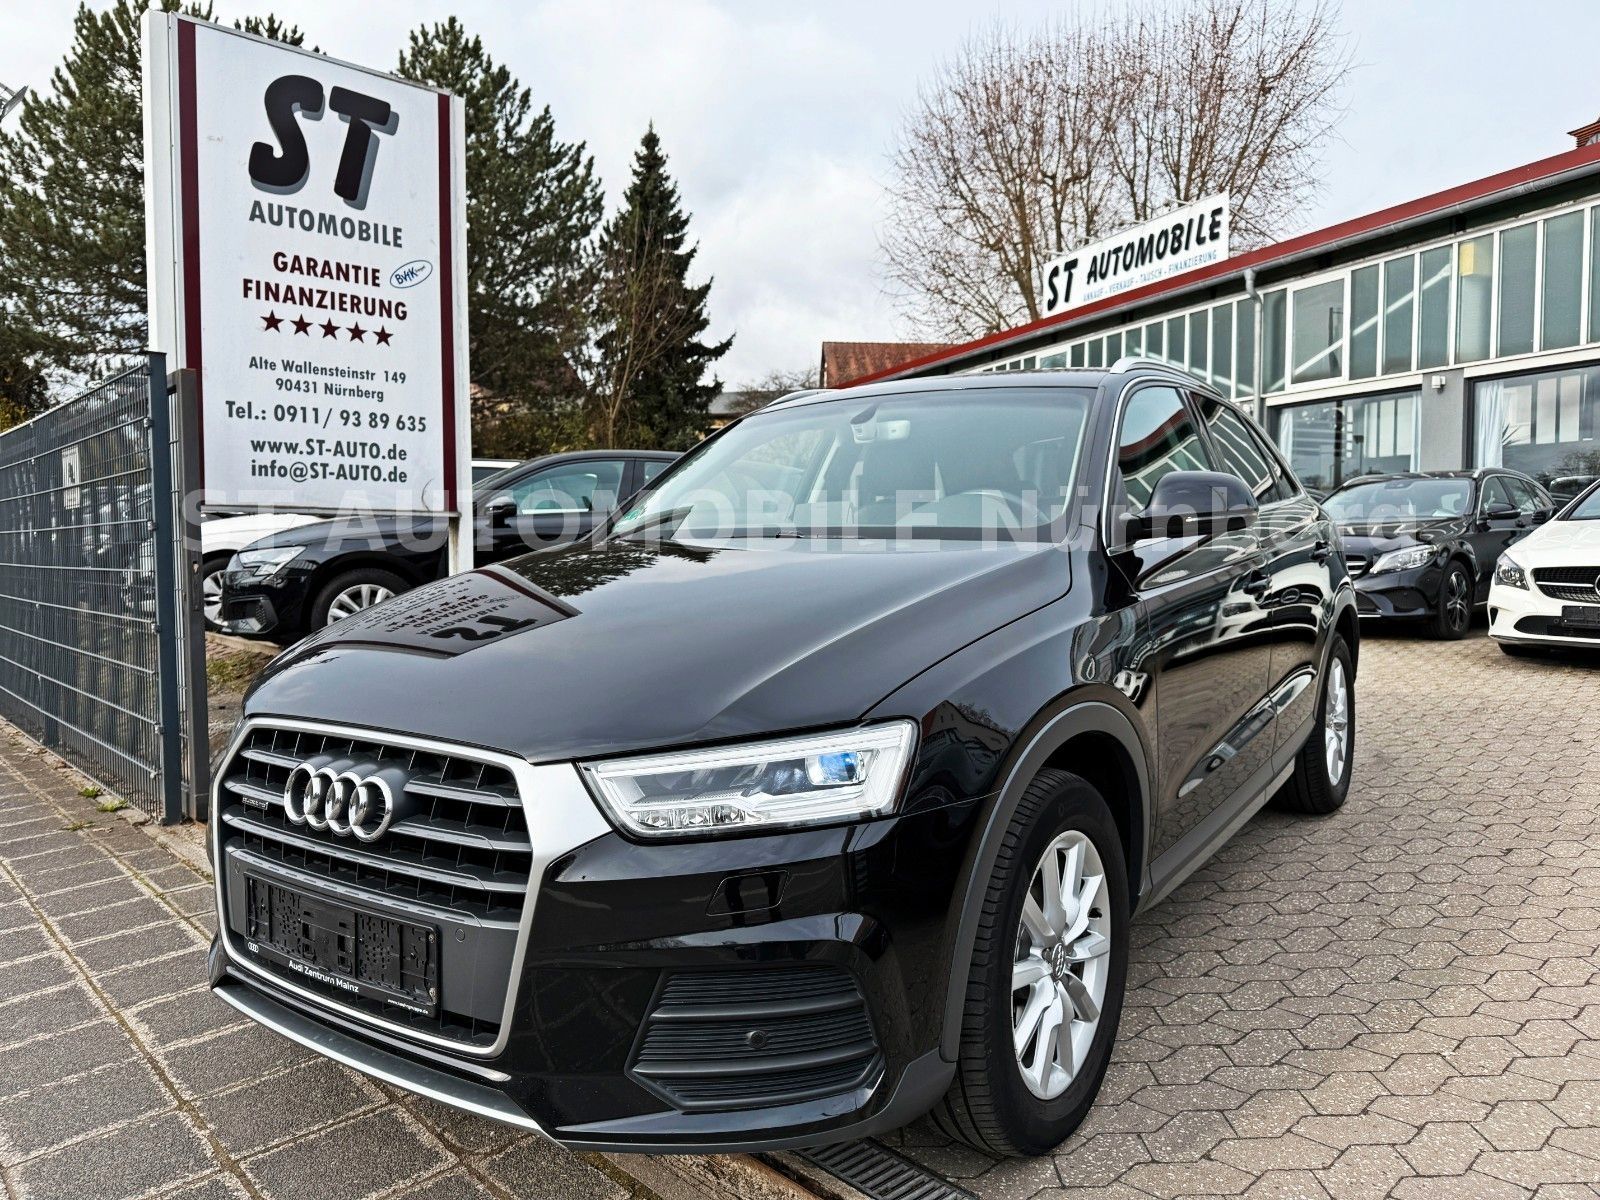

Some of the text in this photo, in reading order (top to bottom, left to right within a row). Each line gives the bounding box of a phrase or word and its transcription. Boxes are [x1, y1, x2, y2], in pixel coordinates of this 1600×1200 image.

[248, 74, 398, 209] ST
[249, 200, 403, 249] AUTOMOBILE
[273, 251, 381, 288] GARANTIE
[1047, 206, 1224, 311] ST AUTOMOBILE
[1109, 277, 1135, 293] VERKAUF
[1140, 268, 1162, 283] TAUSCH
[1168, 249, 1218, 274] FINANZIERUNG
[242, 278, 408, 321] FINANZIERUNG
[249, 356, 407, 384] Alte Wallensteinstr 149
[275, 378, 385, 403] 90431 Nürnberg
[225, 400, 427, 432] Tel.: 0911/ 93 89 635
[250, 438, 408, 461] www.ST-AUTO.de
[251, 459, 408, 483] info@ST-AUTO.de
[288, 960, 360, 993] Audi Zentrum Mainz
